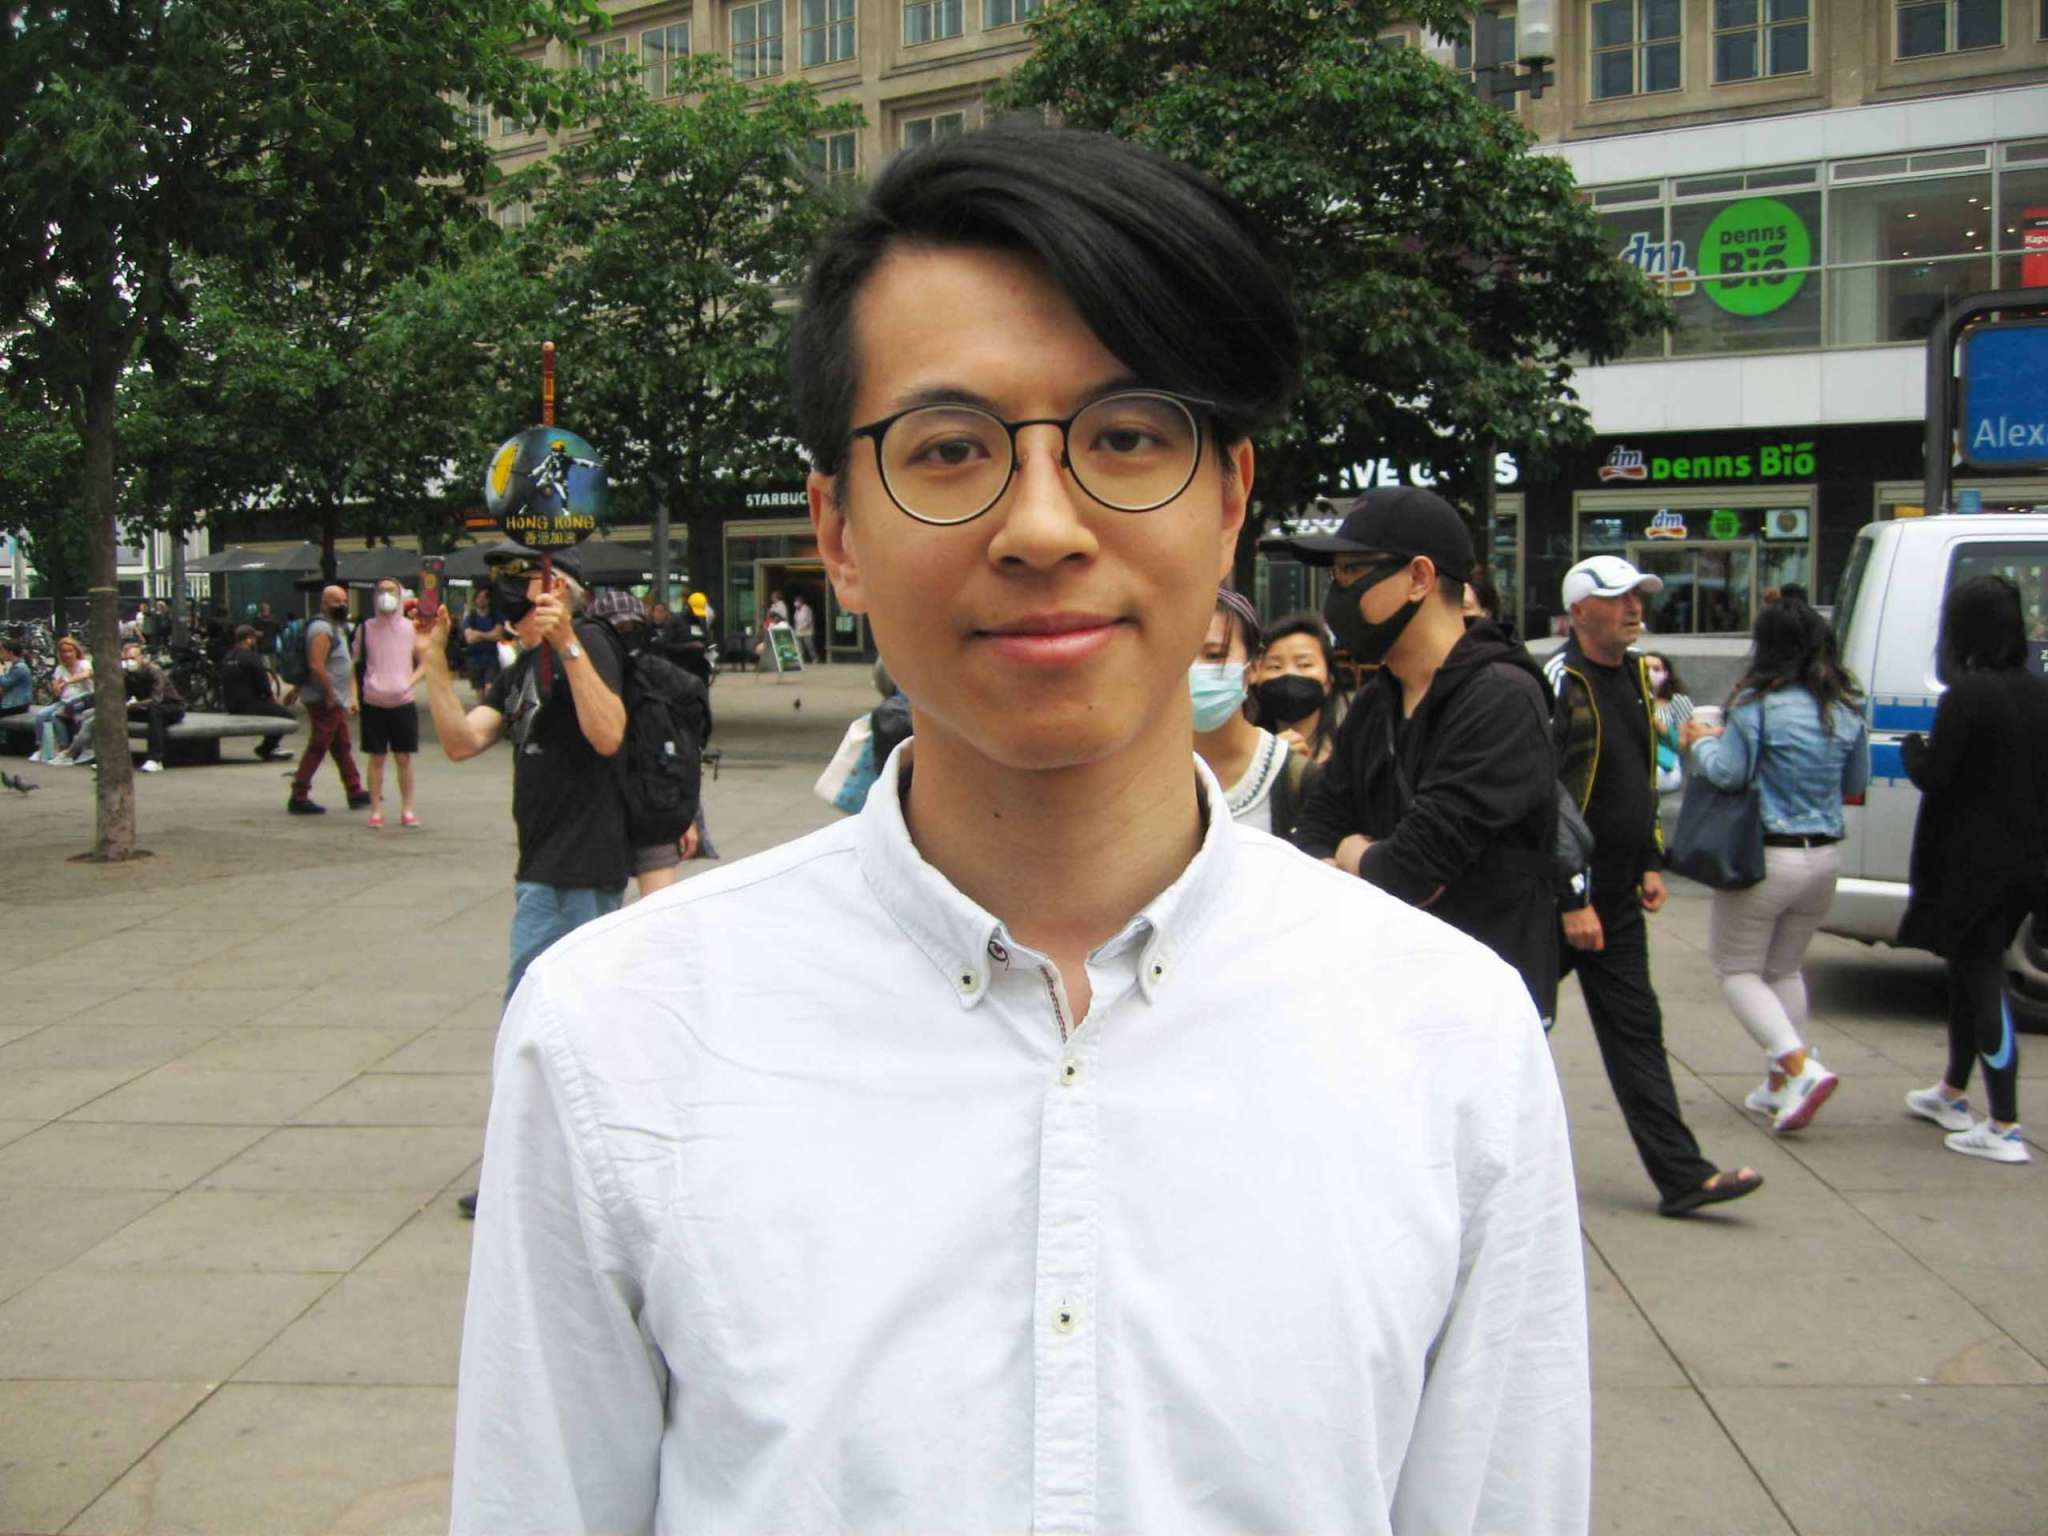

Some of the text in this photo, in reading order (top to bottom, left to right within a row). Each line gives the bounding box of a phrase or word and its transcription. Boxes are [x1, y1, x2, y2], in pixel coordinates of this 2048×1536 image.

[1620, 233, 1682, 273] dm
[1972, 415, 2048, 449] Alex
[1606, 445, 1642, 468] dm
[1409, 451, 1519, 488] GS
[745, 491, 809, 508] STARBUC
[505, 515, 596, 531] HONG KONG
[1651, 509, 1684, 528] dm
